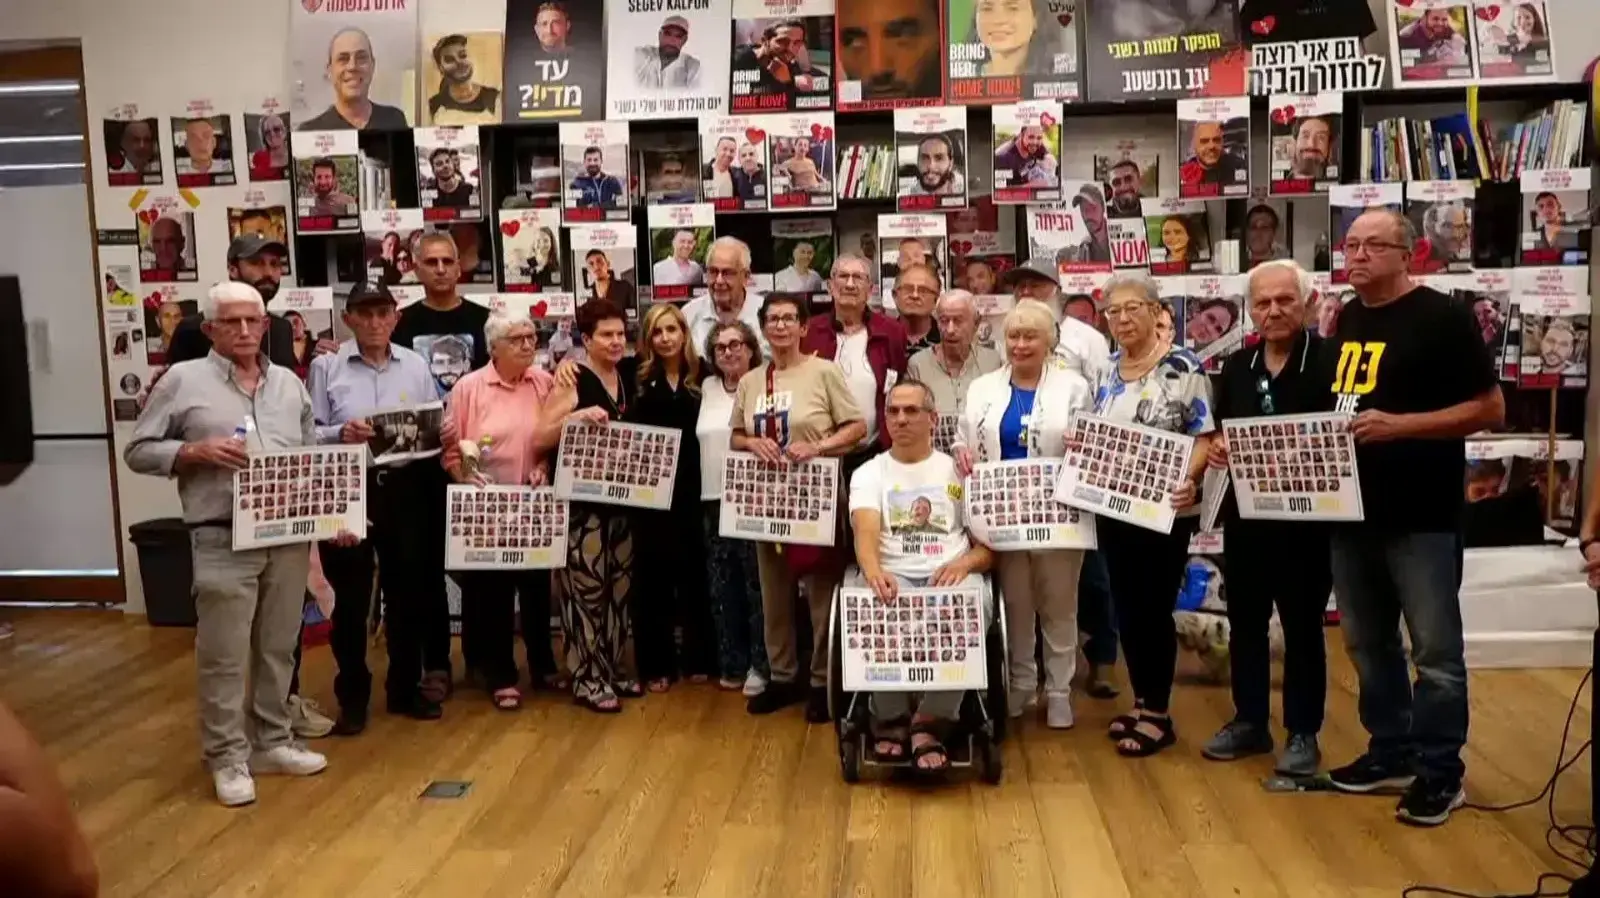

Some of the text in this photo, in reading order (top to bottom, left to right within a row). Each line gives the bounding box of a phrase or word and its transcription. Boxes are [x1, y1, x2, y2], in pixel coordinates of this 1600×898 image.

[949, 43, 985, 60] BRING
[1107, 33, 1221, 59] הופקר למוות בשבי
[1255, 40, 1356, 66] גם אני רוצה
[534, 59, 569, 81] עד
[732, 69, 760, 82] BRING
[1314, 57, 1382, 90] לחזור
[678, 97, 705, 112] הולדת
[708, 96, 721, 110] יום
[1035, 213, 1074, 232] הביתה
[608, 485, 630, 500] נקום
[1109, 495, 1131, 513] נקום
[1289, 496, 1312, 514] נקום
[292, 520, 315, 536] נקום
[770, 522, 791, 537] נקום
[1027, 527, 1051, 543] נקום
[502, 551, 524, 565] נקום
[909, 667, 934, 684] נקום
